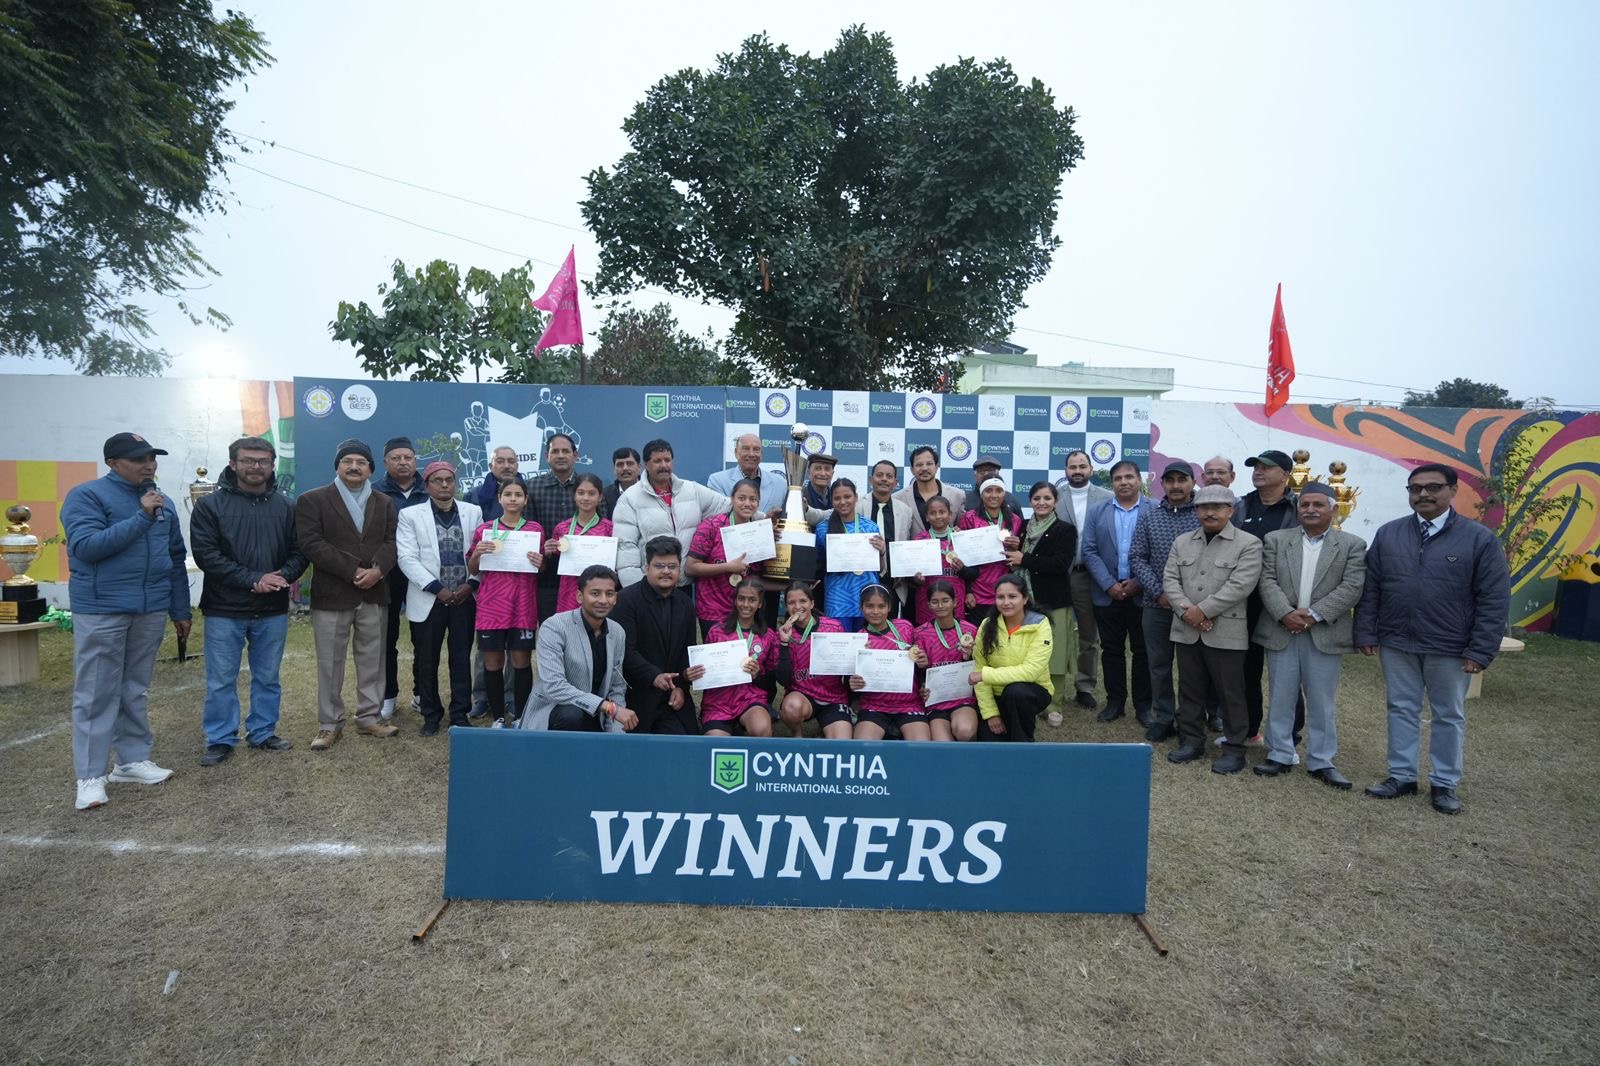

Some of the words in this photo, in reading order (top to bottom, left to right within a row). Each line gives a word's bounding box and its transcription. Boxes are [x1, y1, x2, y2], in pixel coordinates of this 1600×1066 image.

[516, 453, 537, 462] IDE
[752, 752, 888, 780] CYNTHIA
[756, 782, 842, 794] INTERNATIONAL
[844, 784, 890, 795] SCHOOL
[590, 810, 1007, 884] WINNERS
